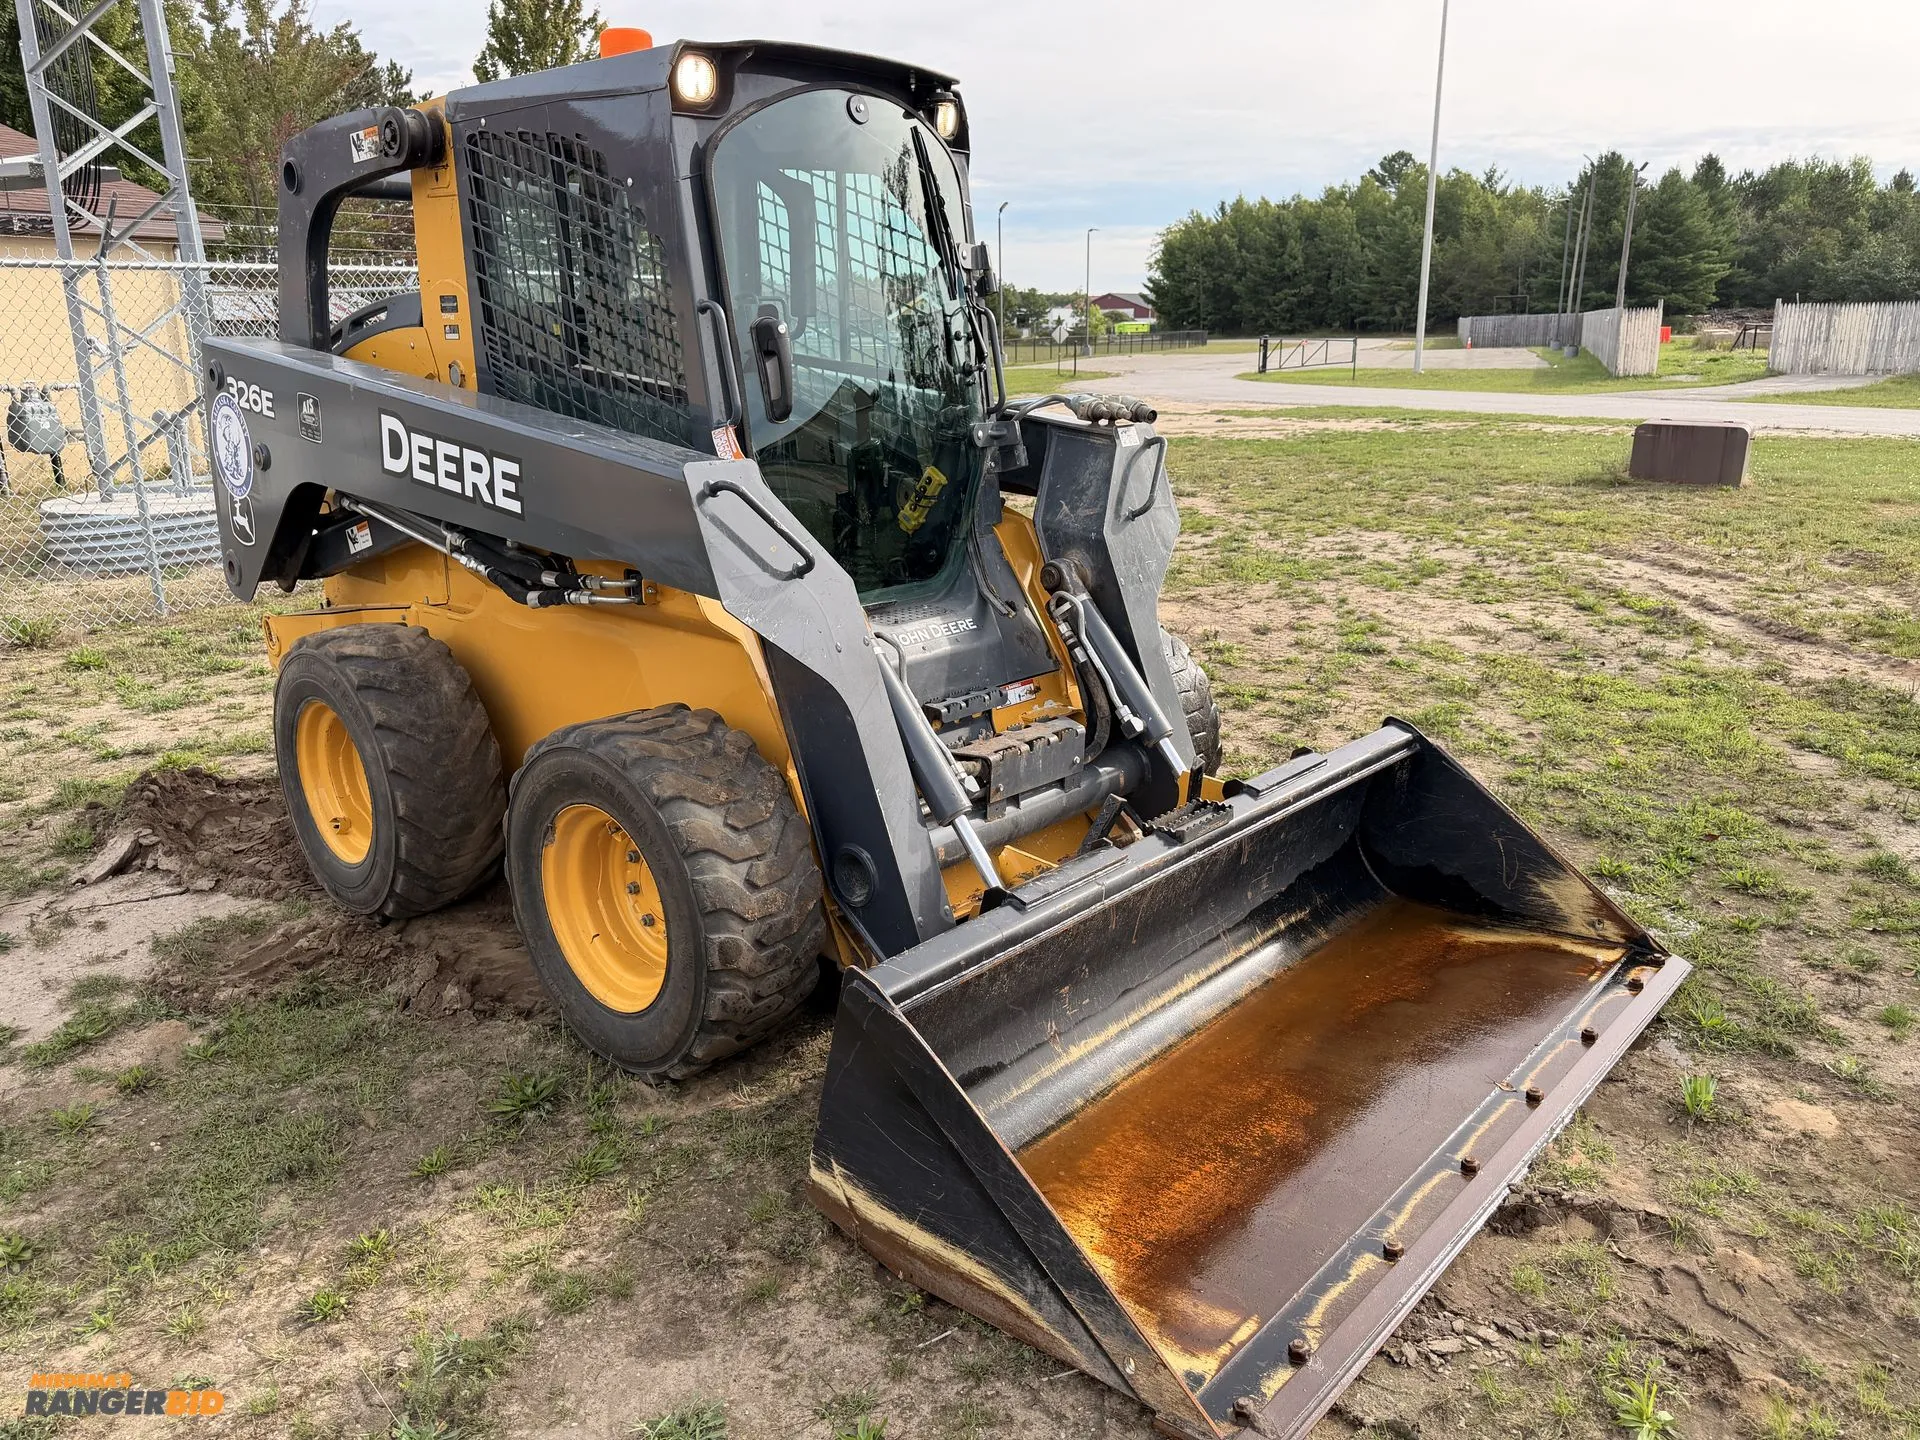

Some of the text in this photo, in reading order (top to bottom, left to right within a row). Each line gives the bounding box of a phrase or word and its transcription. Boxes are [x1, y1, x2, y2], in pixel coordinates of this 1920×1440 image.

[226, 376, 275, 418] 326E
[380, 413, 522, 514] DEERE
[892, 618, 977, 650] JOHN DEERE
